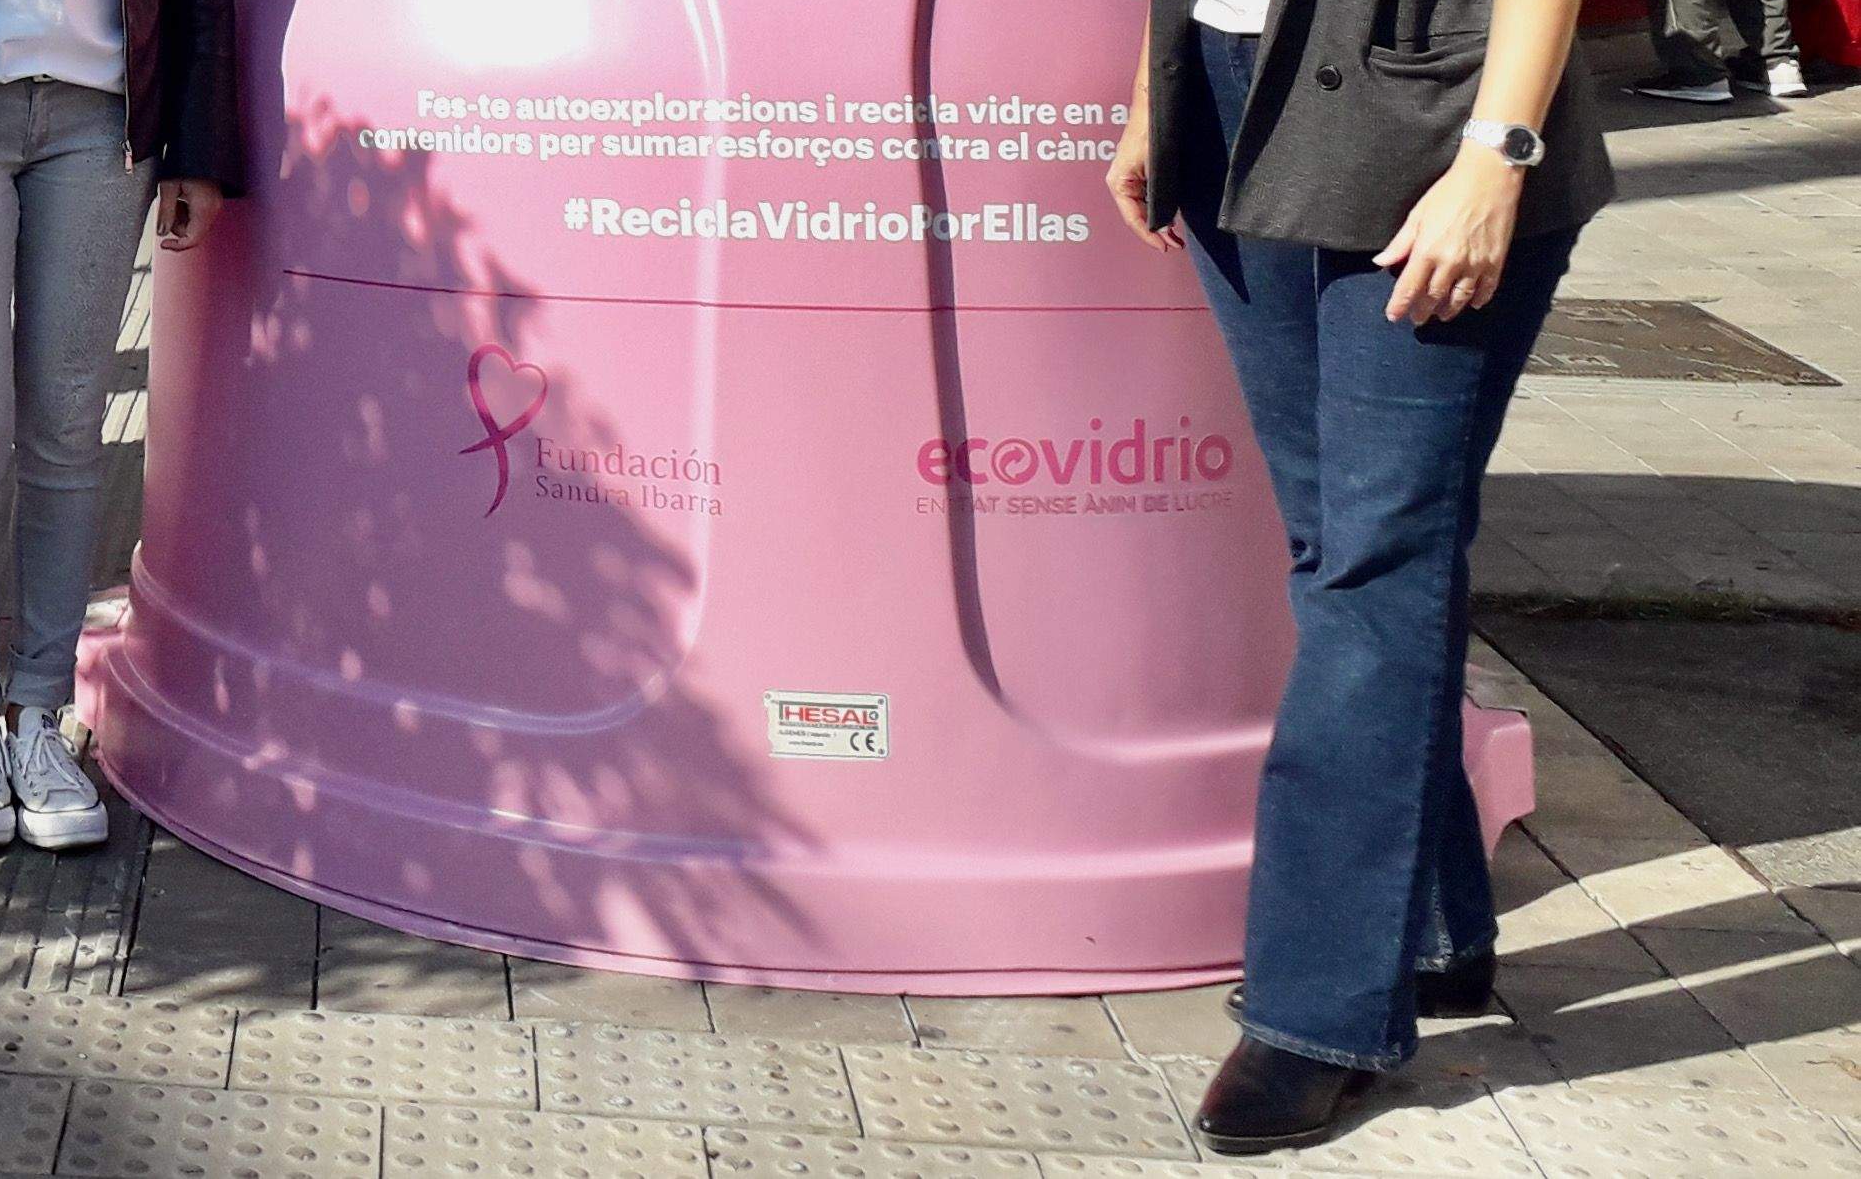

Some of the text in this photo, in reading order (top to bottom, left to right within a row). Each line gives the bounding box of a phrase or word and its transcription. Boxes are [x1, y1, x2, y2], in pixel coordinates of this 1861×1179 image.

[417, 90, 510, 120] Fes-te
[516, 92, 819, 127] autoexploracions
[826, 94, 836, 123] i
[844, 94, 958, 125] recicla
[966, 95, 1056, 125] vidre
[1063, 103, 1104, 125] en
[359, 125, 1118, 167] contenidors per sumar esforços contra el cànc
[564, 197, 1090, 243] #ReciclaVidrioPorEllas
[535, 437, 722, 485] Fundación
[916, 415, 1233, 486] ecovidrio
[535, 475, 723, 517] Sandra Ibarra
[1006, 493, 1077, 515] SENSE
[1143, 493, 1169, 513] DE
[1175, 490, 1234, 512] LUCRE
